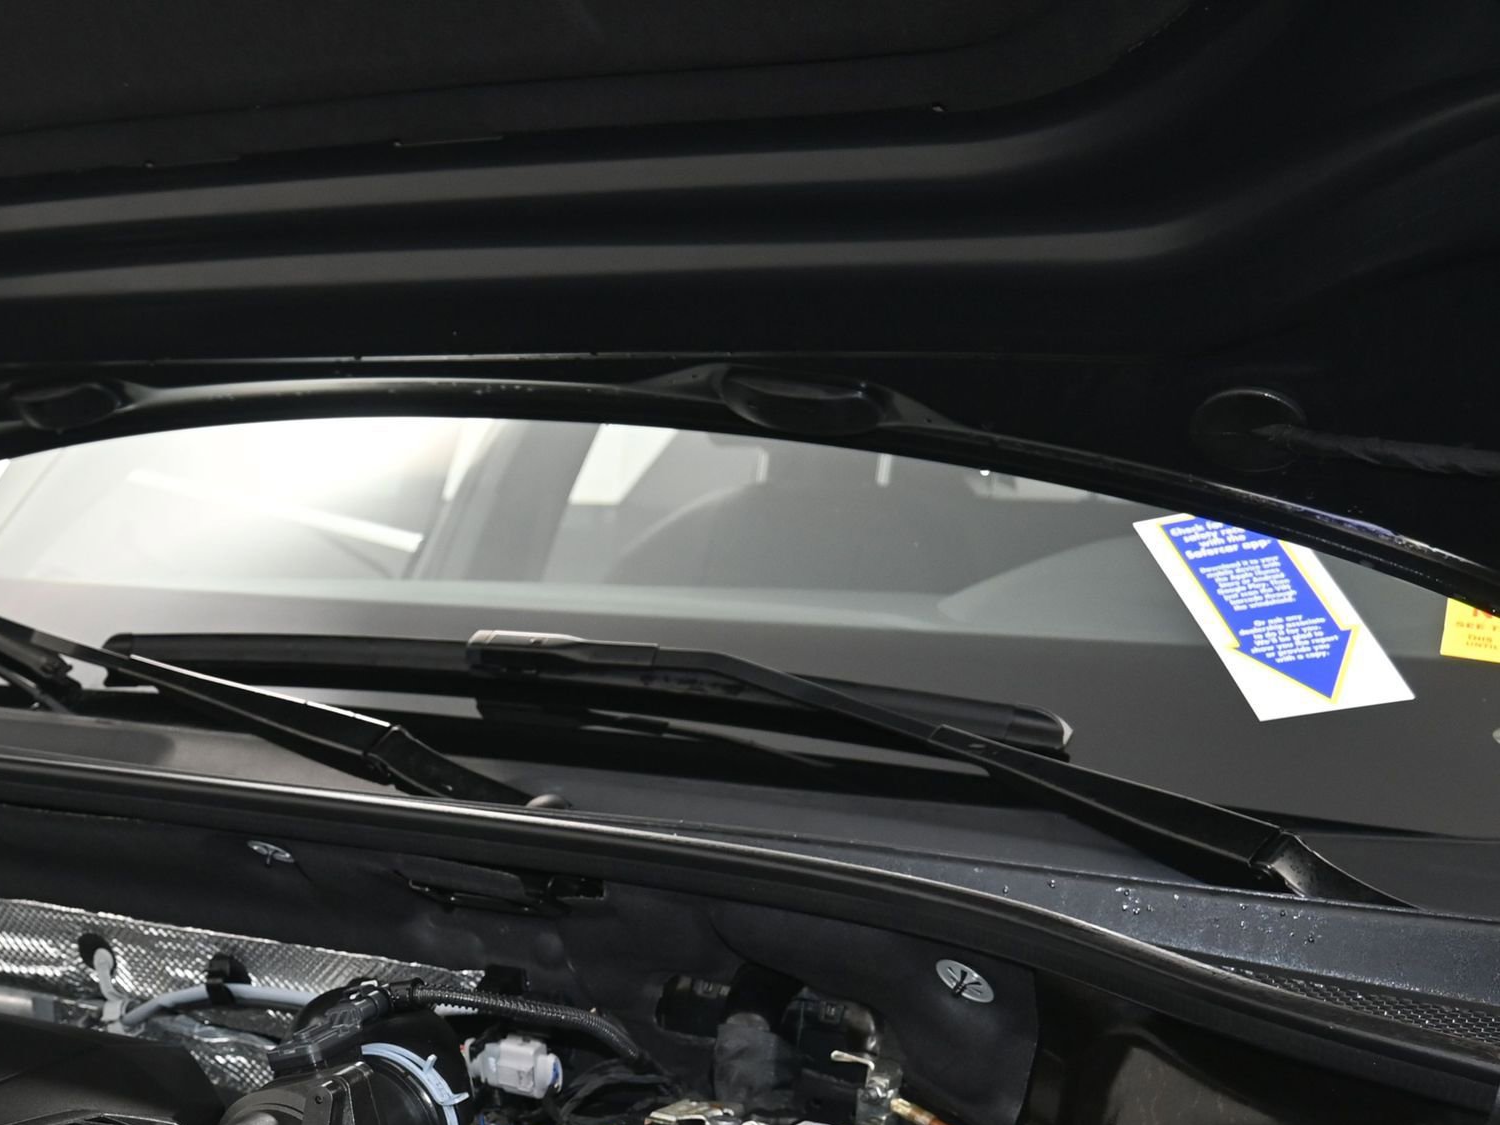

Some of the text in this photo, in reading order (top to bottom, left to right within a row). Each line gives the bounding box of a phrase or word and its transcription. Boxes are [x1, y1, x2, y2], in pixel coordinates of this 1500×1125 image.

[1169, 523, 1205, 537] Check
[1182, 531, 1218, 543] safety
[1198, 534, 1247, 547] with the
